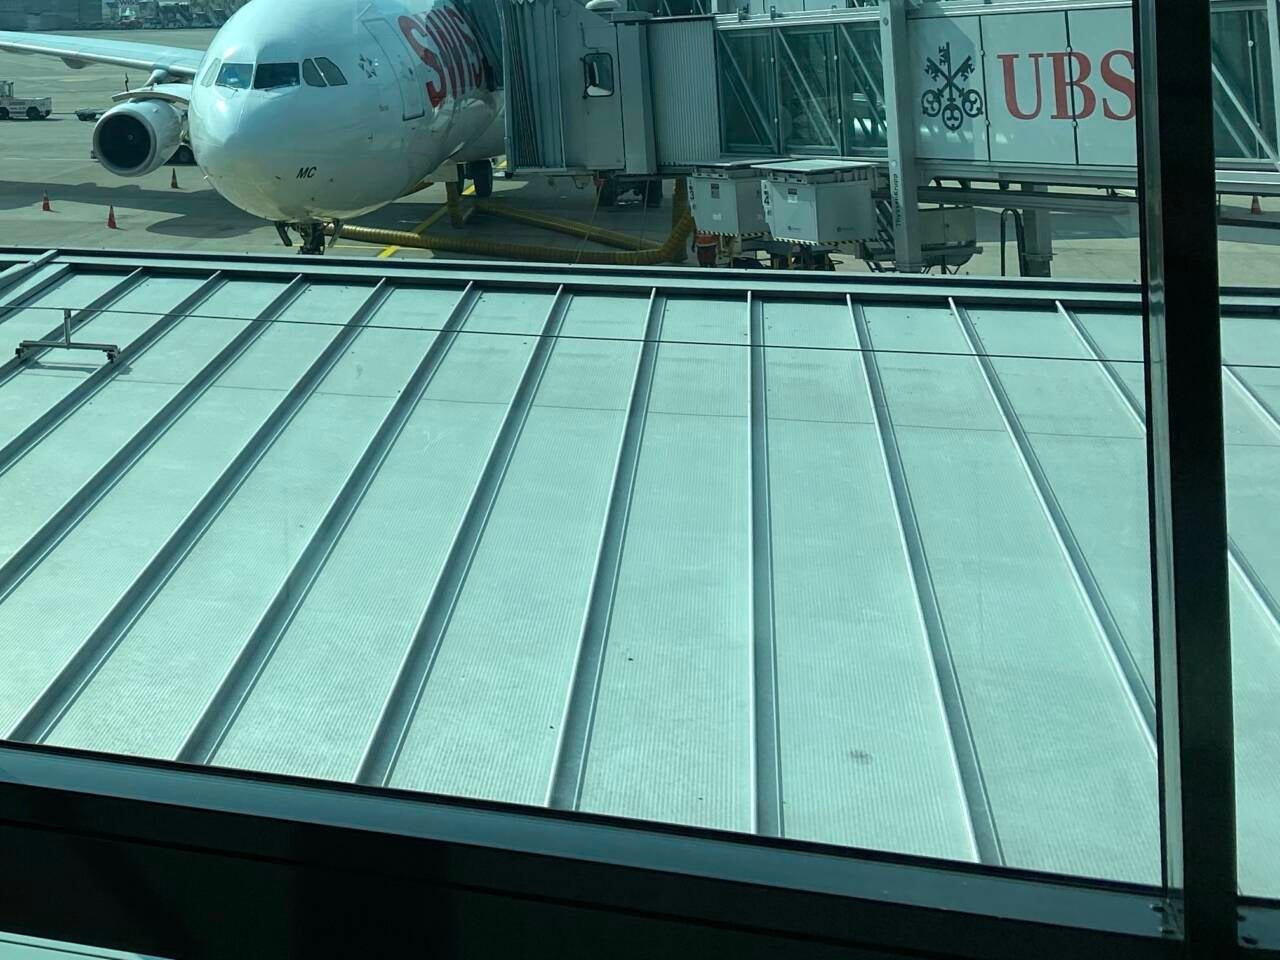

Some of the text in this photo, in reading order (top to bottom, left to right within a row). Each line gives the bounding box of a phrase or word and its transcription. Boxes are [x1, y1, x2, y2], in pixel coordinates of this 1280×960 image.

[397, 5, 485, 107] SWIS
[997, 49, 1136, 121] UBS
[296, 166, 317, 179] MC
